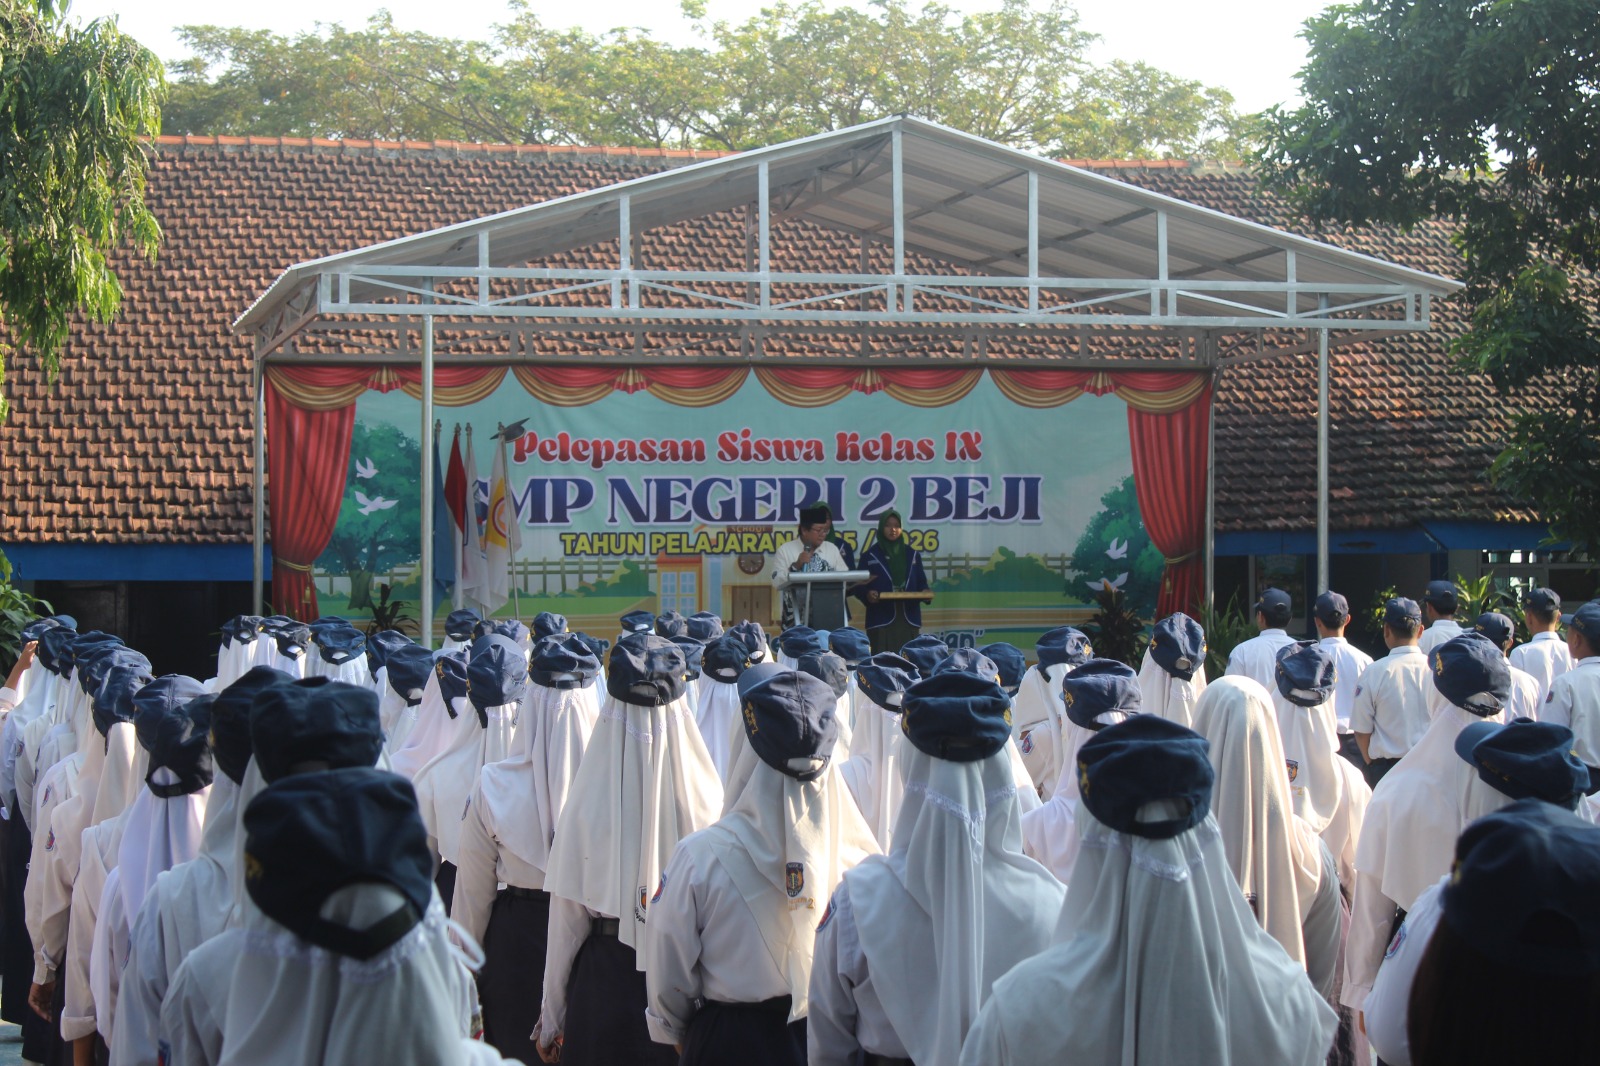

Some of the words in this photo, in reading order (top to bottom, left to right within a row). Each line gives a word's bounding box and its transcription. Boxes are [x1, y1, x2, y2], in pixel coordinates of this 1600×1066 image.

[512, 431, 707, 469] Pelepasan
[717, 428, 825, 462] Siswa
[834, 431, 936, 462] Kelas
[944, 430, 983, 462] IX
[607, 476, 846, 523] NEGERI
[858, 476, 897, 522] 2
[908, 475, 1043, 521] BEJI
[560, 531, 646, 555] TAHUN
[650, 530, 794, 554] PELAJARAN
